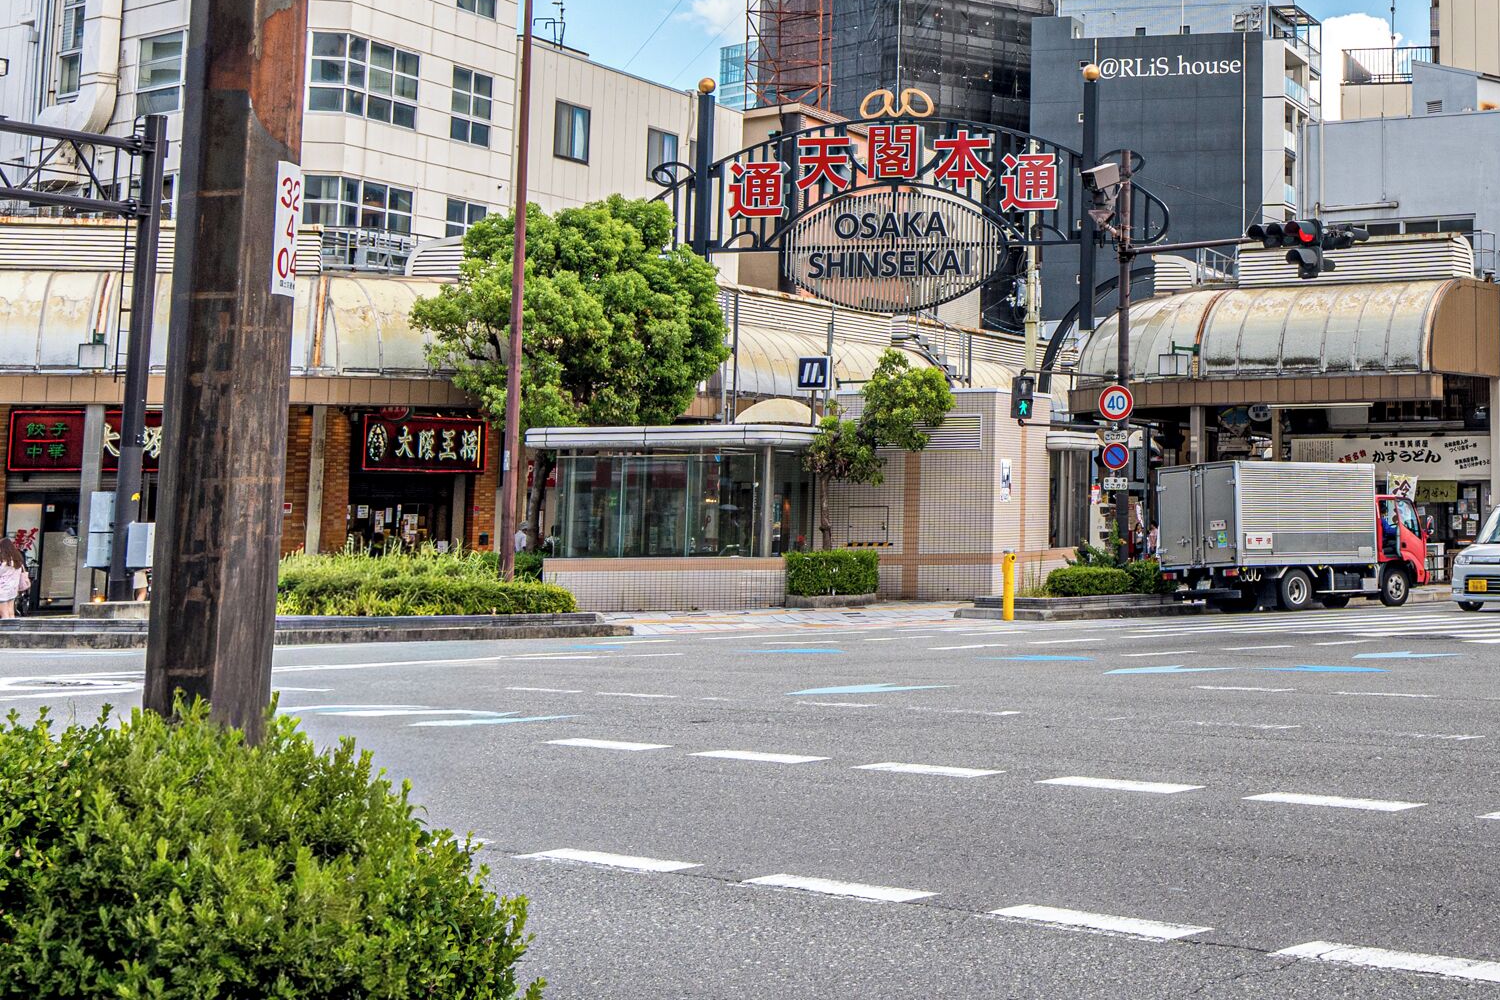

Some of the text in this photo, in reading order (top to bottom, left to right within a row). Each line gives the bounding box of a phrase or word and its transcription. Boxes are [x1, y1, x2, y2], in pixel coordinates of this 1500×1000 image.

[1099, 53, 1242, 80] @RLiS_house
[727, 124, 1061, 220] 通天閣本通
[280, 176, 301, 213] 32
[286, 213, 295, 245] 4
[833, 210, 948, 240] OSAKA
[807, 247, 972, 280] SHINSEKAI
[1106, 395, 1126, 412] 40
[26, 422, 69, 438] 餃子
[395, 424, 478, 462] 大阪王将
[1105, 432, 1127, 441] ここから
[26, 443, 67, 459] 中華
[1372, 449, 1442, 464] かすうどん
